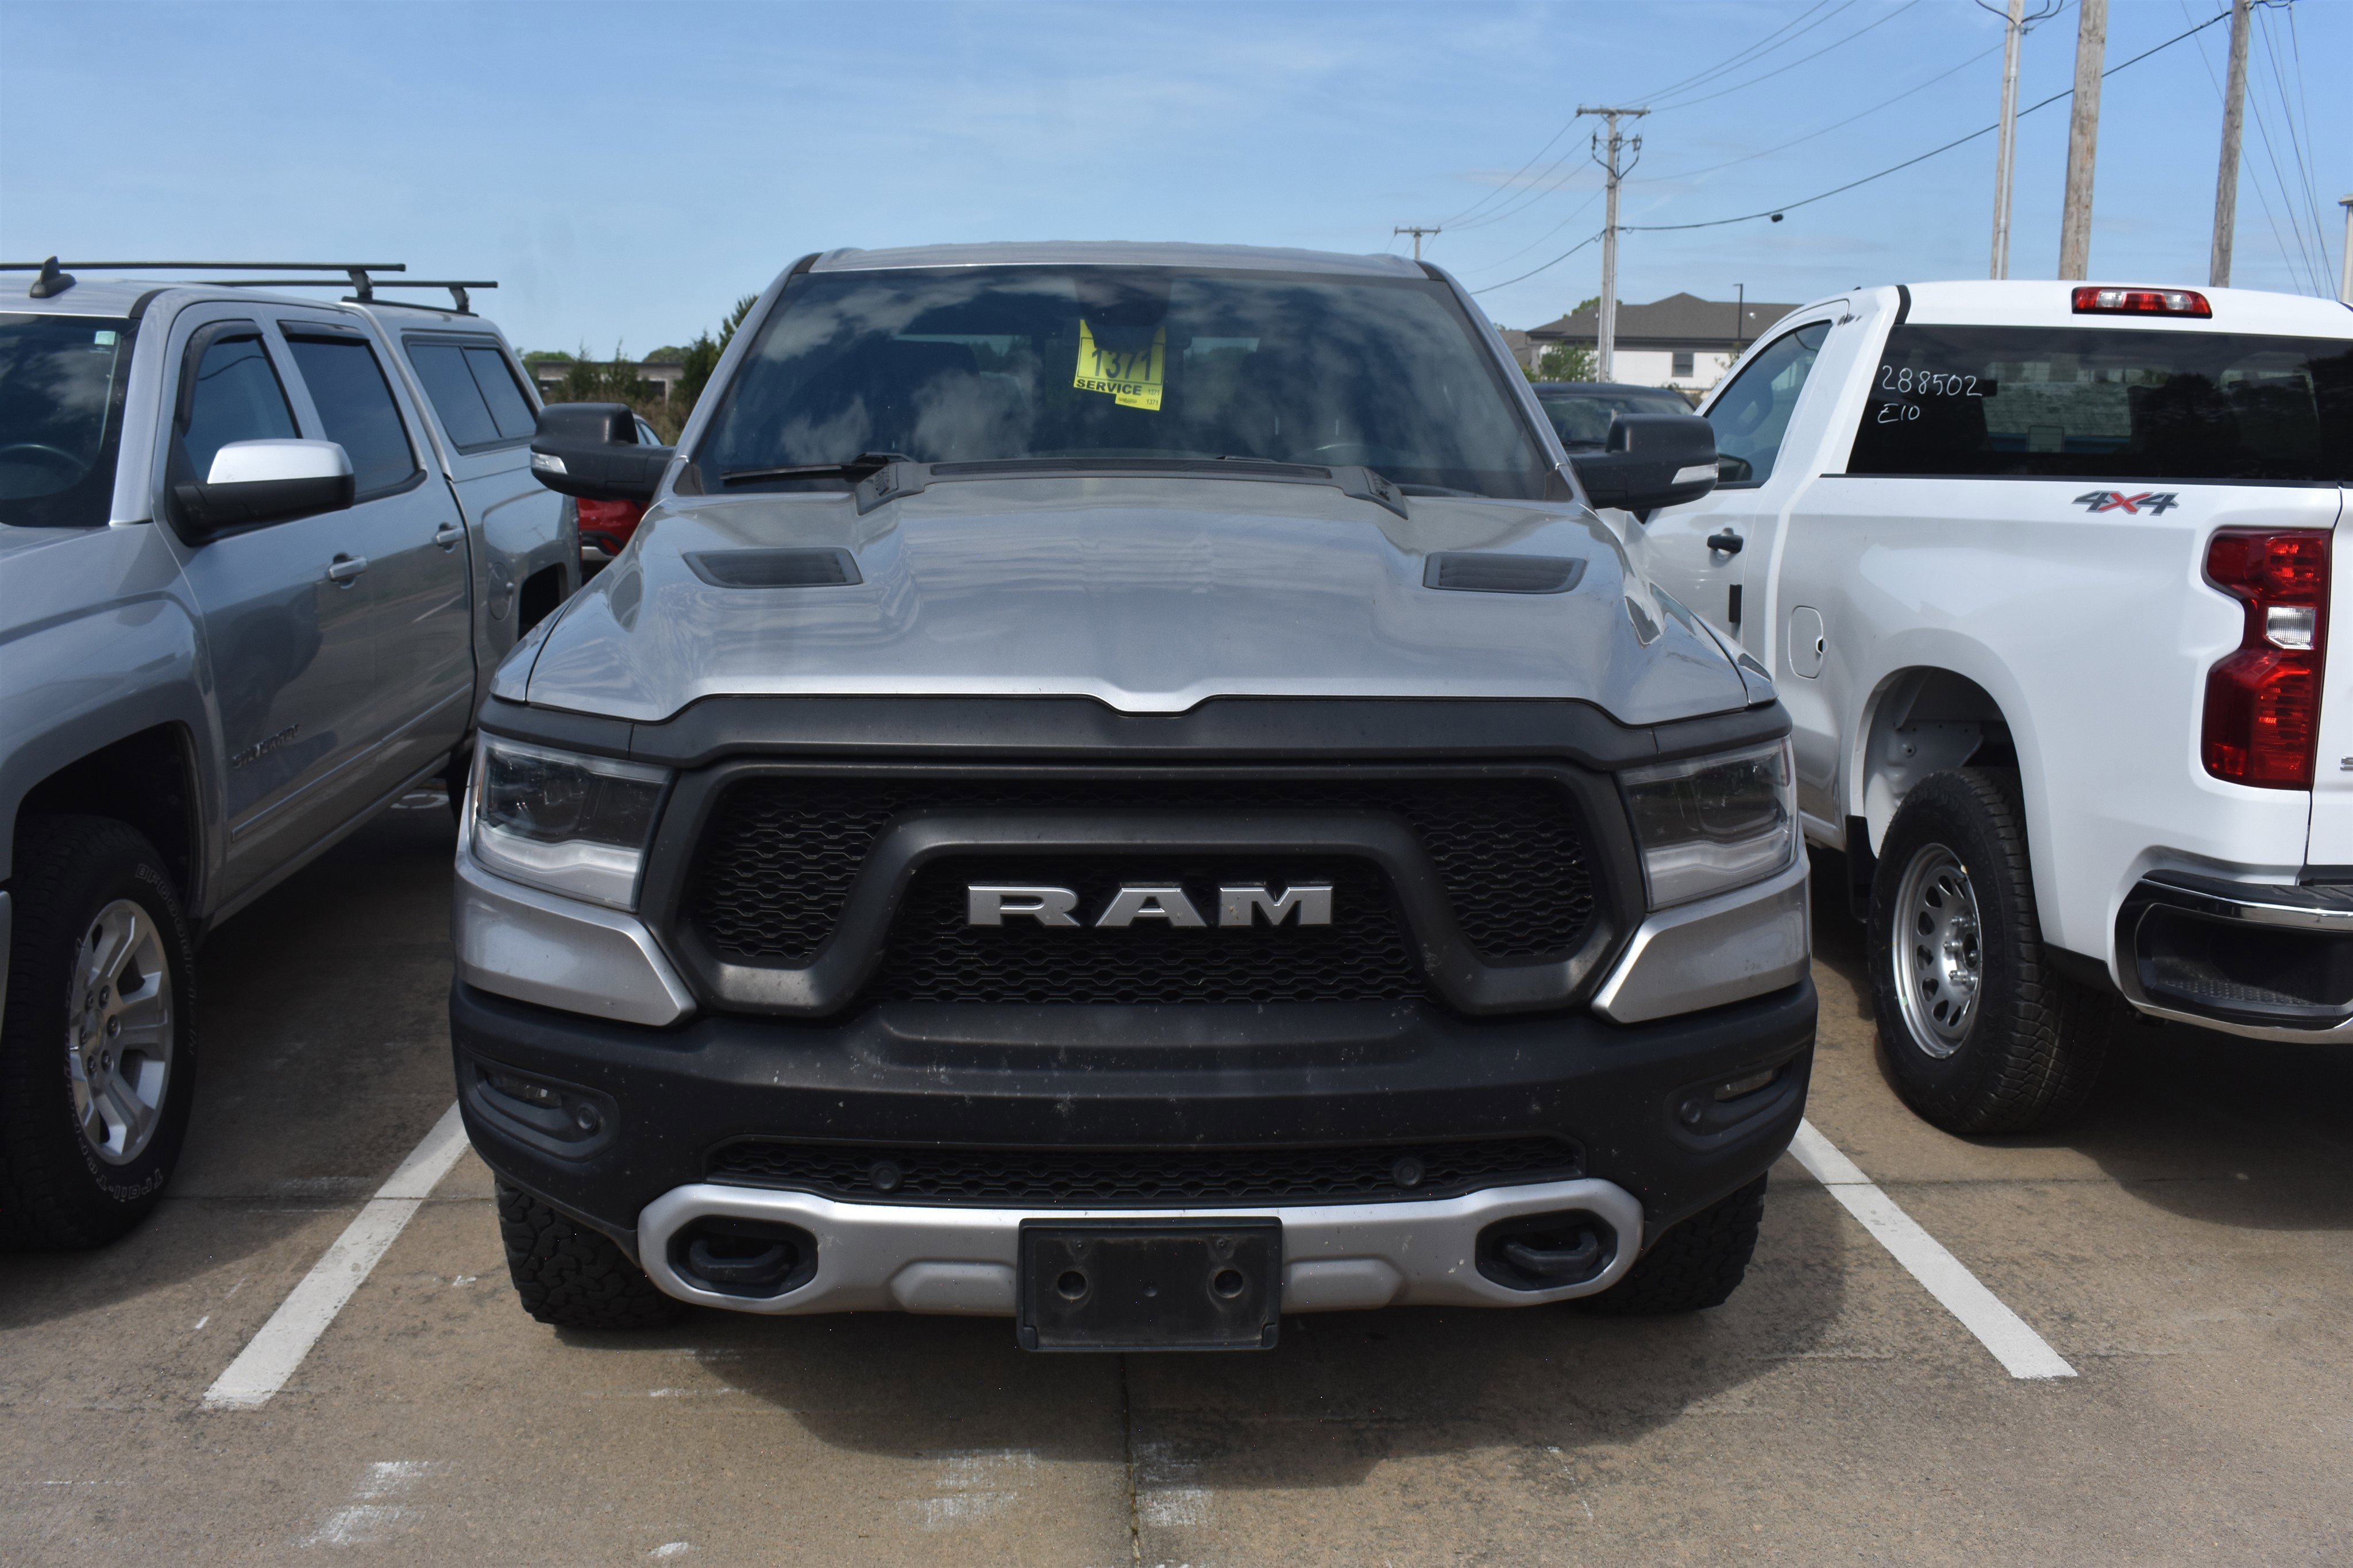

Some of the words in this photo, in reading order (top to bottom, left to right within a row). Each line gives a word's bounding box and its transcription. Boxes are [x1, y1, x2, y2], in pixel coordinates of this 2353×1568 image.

[1091, 347, 1152, 381] 1371
[1076, 379, 1142, 396] SERVICE
[1148, 388, 1160, 396] 1371
[1882, 365, 1982, 396] 288502
[1877, 403, 1920, 423] E10
[968, 886, 1333, 927] RAM
